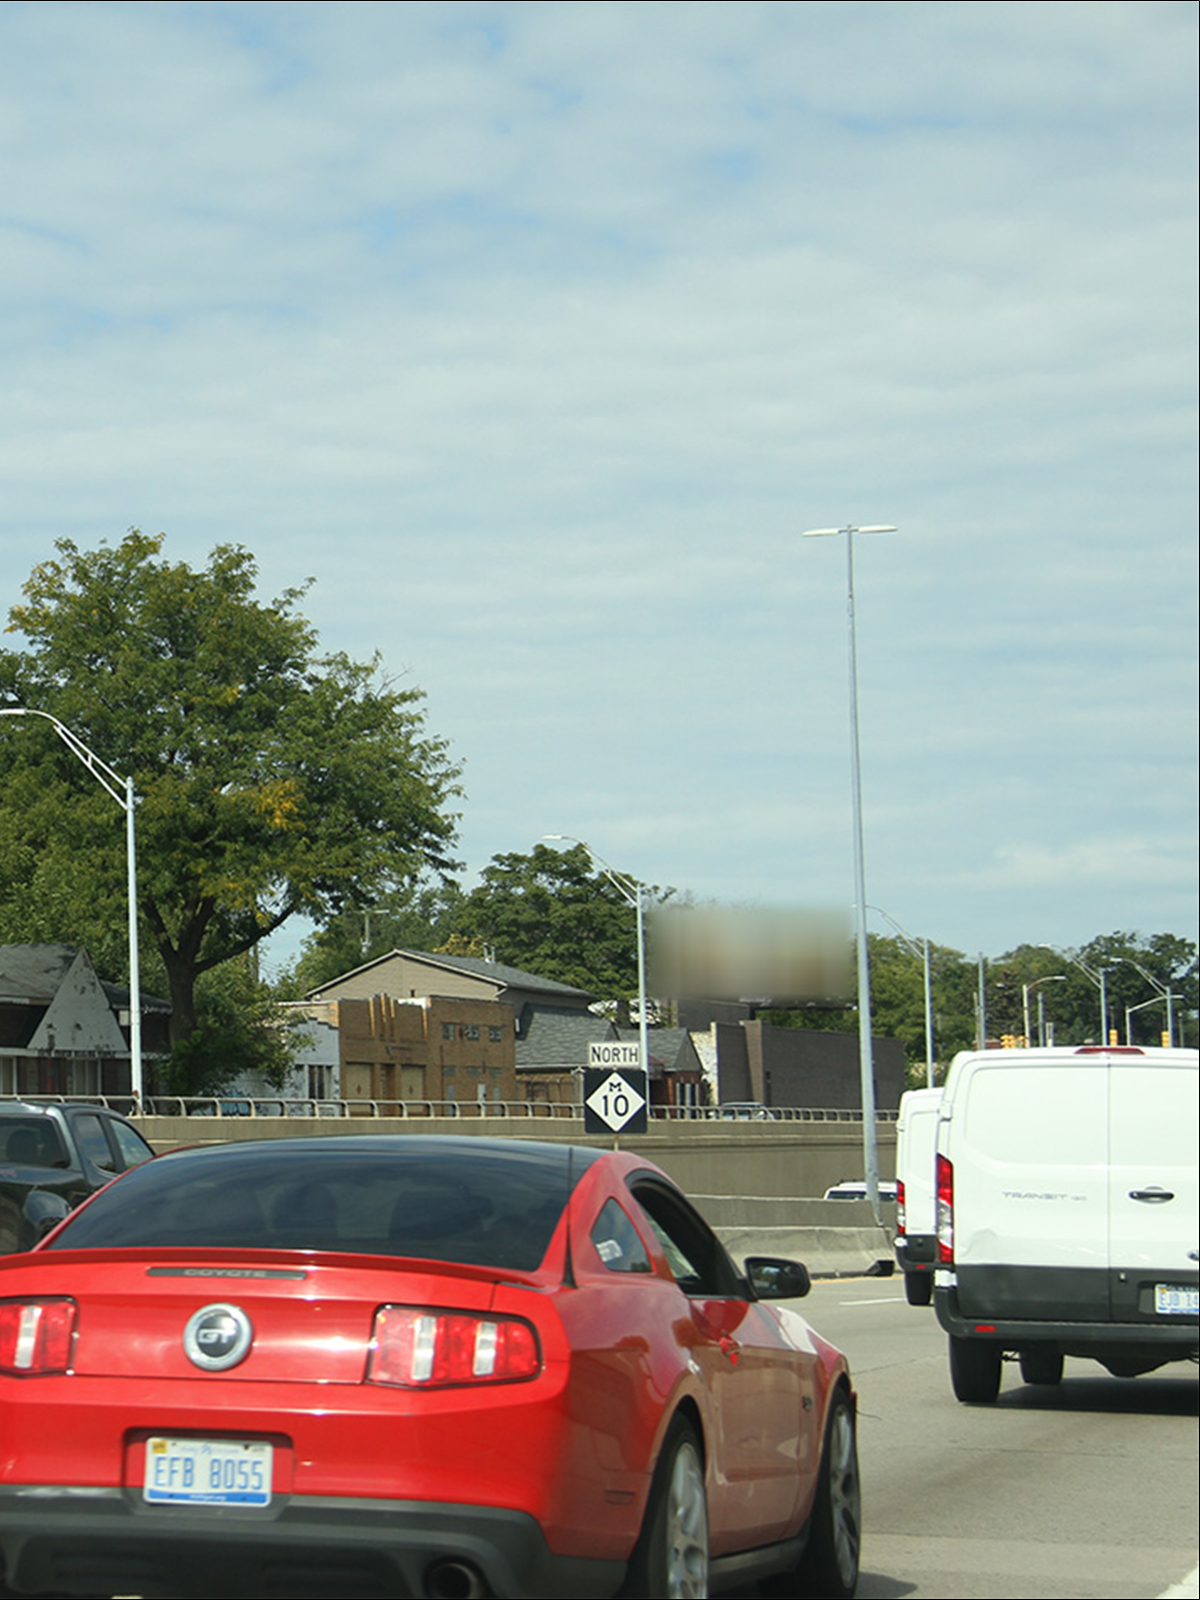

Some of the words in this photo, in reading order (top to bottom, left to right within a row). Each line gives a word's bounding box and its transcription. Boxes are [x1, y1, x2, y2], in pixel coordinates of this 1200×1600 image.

[591, 1046, 638, 1063] NORTH
[608, 1082, 622, 1092] M
[602, 1094, 629, 1117] 10
[184, 1269, 266, 1278] COYOTE
[198, 1329, 236, 1343] GT
[154, 1456, 195, 1488] EFB
[209, 1458, 263, 1491] 8055
